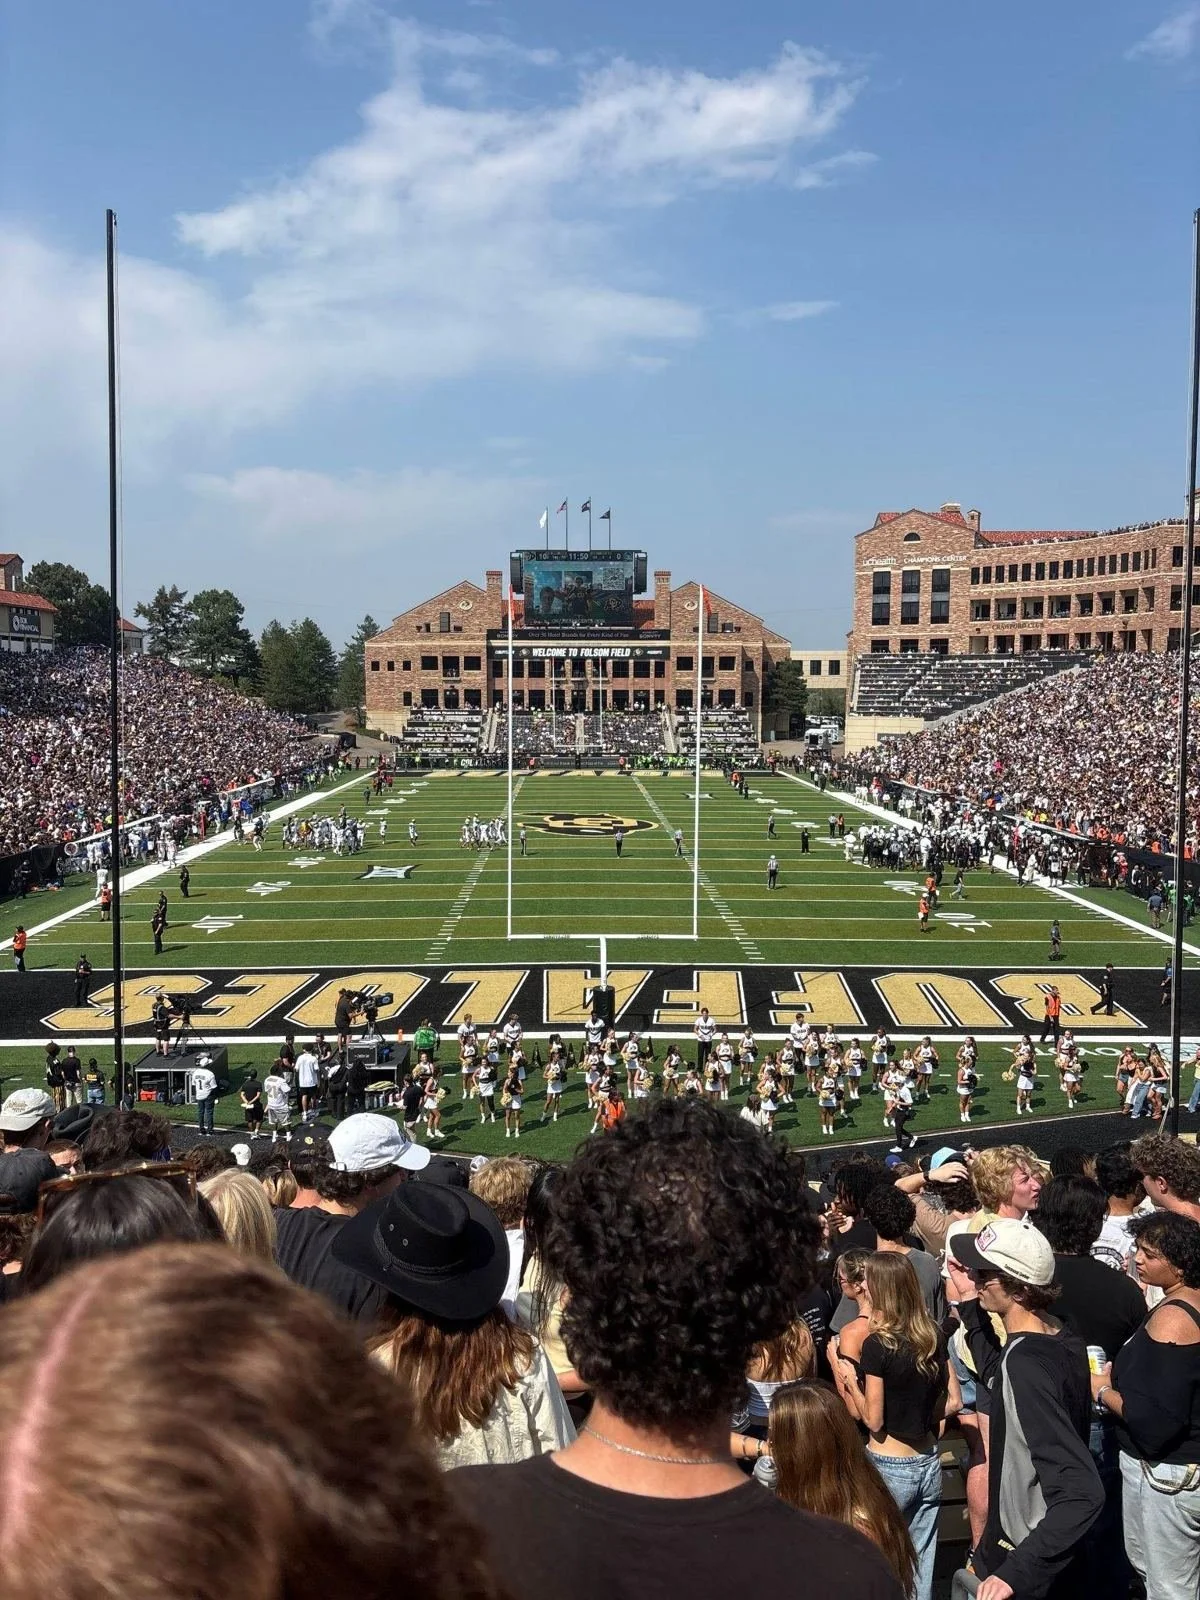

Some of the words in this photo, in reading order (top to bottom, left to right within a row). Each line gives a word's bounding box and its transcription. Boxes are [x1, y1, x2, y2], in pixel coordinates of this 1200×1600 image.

[903, 556, 941, 564] CHAMPIONS
[942, 555, 968, 563] CENTER
[532, 648, 567, 657] WELCOME
[568, 648, 578, 657] TO
[580, 648, 610, 657] FOLSOM
[611, 648, 631, 657] FIELD
[39, 969, 1149, 1030] BUFFALOES
